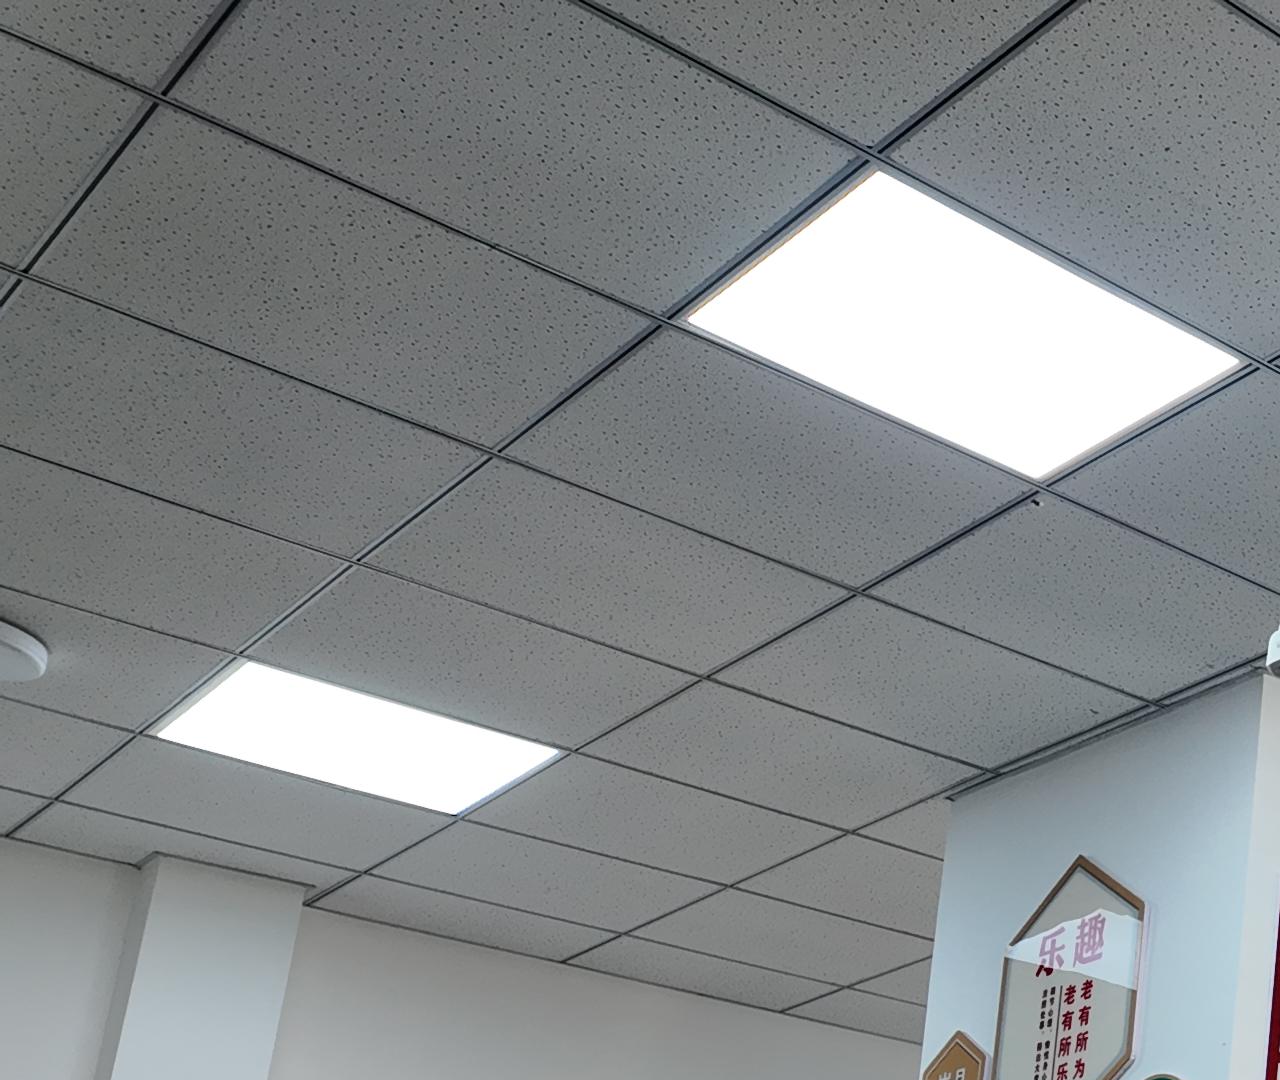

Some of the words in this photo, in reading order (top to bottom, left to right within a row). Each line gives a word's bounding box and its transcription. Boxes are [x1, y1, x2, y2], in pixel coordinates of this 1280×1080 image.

[1035, 912, 1106, 977] 乐趣
[1072, 979, 1094, 1080] 老有所为
